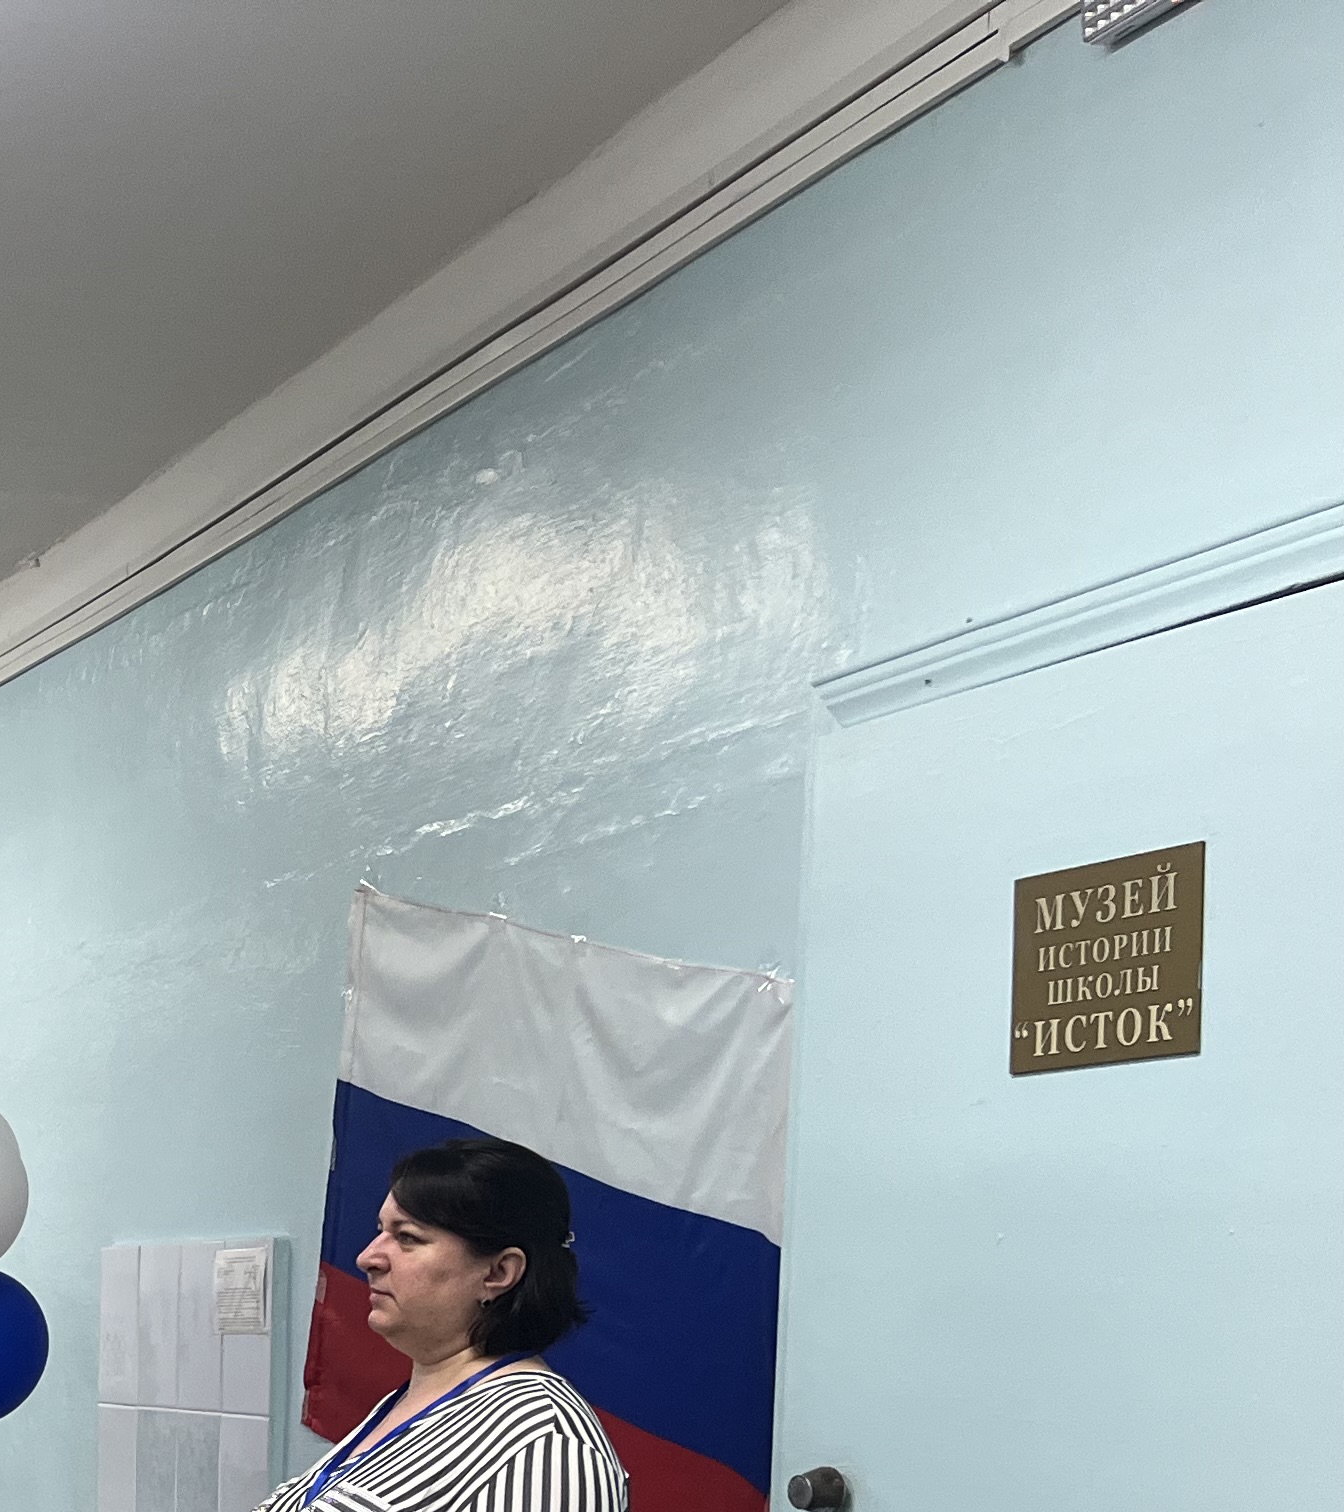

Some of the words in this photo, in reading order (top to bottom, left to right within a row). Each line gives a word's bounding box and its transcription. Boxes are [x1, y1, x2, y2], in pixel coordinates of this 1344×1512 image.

[1033, 862, 1178, 934] МУЗЕЙ
[1037, 926, 1173, 972] ИСТОРИИ
[1047, 964, 1160, 1006] ШКОЛЫ
